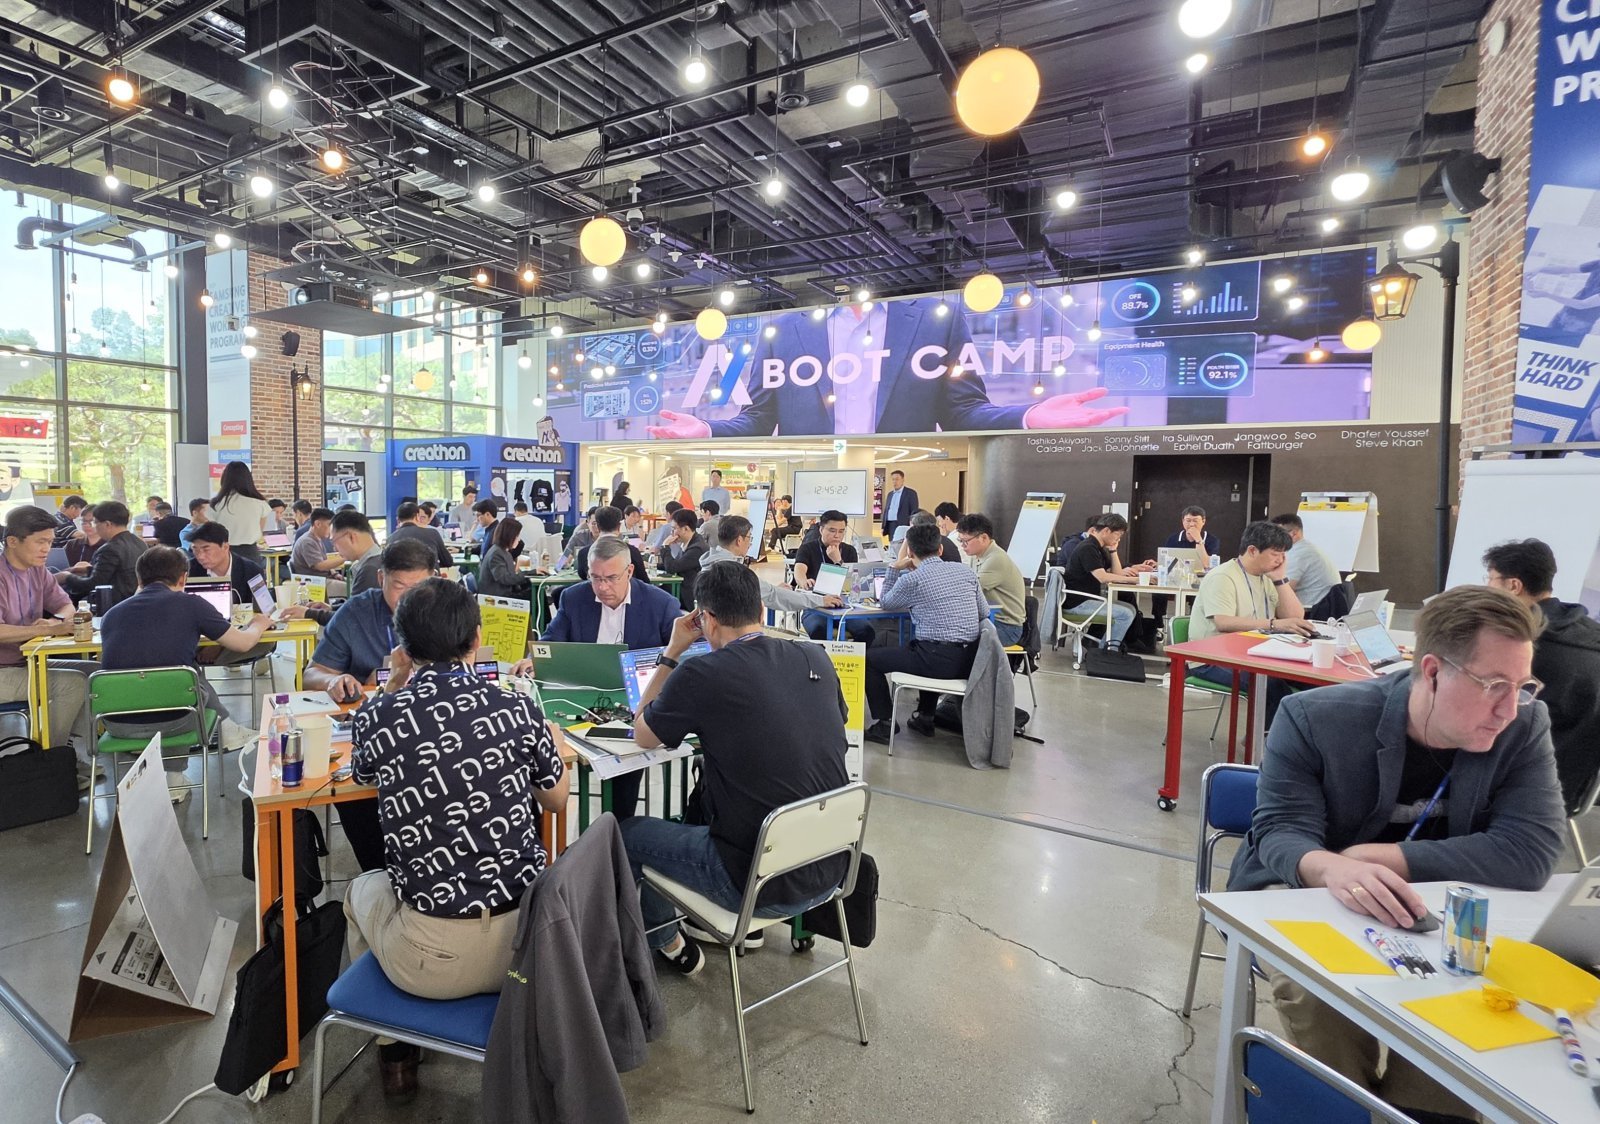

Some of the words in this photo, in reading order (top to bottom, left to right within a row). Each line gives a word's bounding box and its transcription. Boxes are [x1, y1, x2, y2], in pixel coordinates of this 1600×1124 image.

[209, 285, 245, 300] SAMSNG
[209, 300, 245, 317] CREATVE
[210, 333, 246, 349] PROGRAM
[762, 349, 891, 389] BOOT
[911, 335, 1075, 380] CAMP
[1527, 351, 1599, 376] THINK
[1208, 371, 1238, 379] 92.1%
[1519, 368, 1584, 391] HARD
[1104, 436, 1131, 444] Sonny
[1162, 434, 1175, 442] Ira
[1177, 433, 1214, 442] Sullivan
[1234, 432, 1287, 442] Jangwoo
[1294, 431, 1317, 440] Seo
[1341, 430, 1381, 439] Dhafer
[1385, 428, 1430, 438] Youssef
[1036, 445, 1072, 453] Caldera
[1355, 438, 1389, 448] Steve
[1392, 438, 1423, 447] Khan
[405, 443, 466, 461] creathon
[503, 445, 562, 463] creathon
[814, 485, 848, 495] 12:45:22
[537, 647, 547, 655] 15
[363, 708, 420, 762] and
[426, 688, 488, 732] per
[415, 731, 462, 765] se
[470, 700, 532, 740] and
[383, 766, 449, 818] and
[452, 739, 515, 792] per
[443, 791, 491, 825] se
[498, 764, 531, 797] an
[408, 826, 479, 877] and
[475, 848, 521, 880] se
